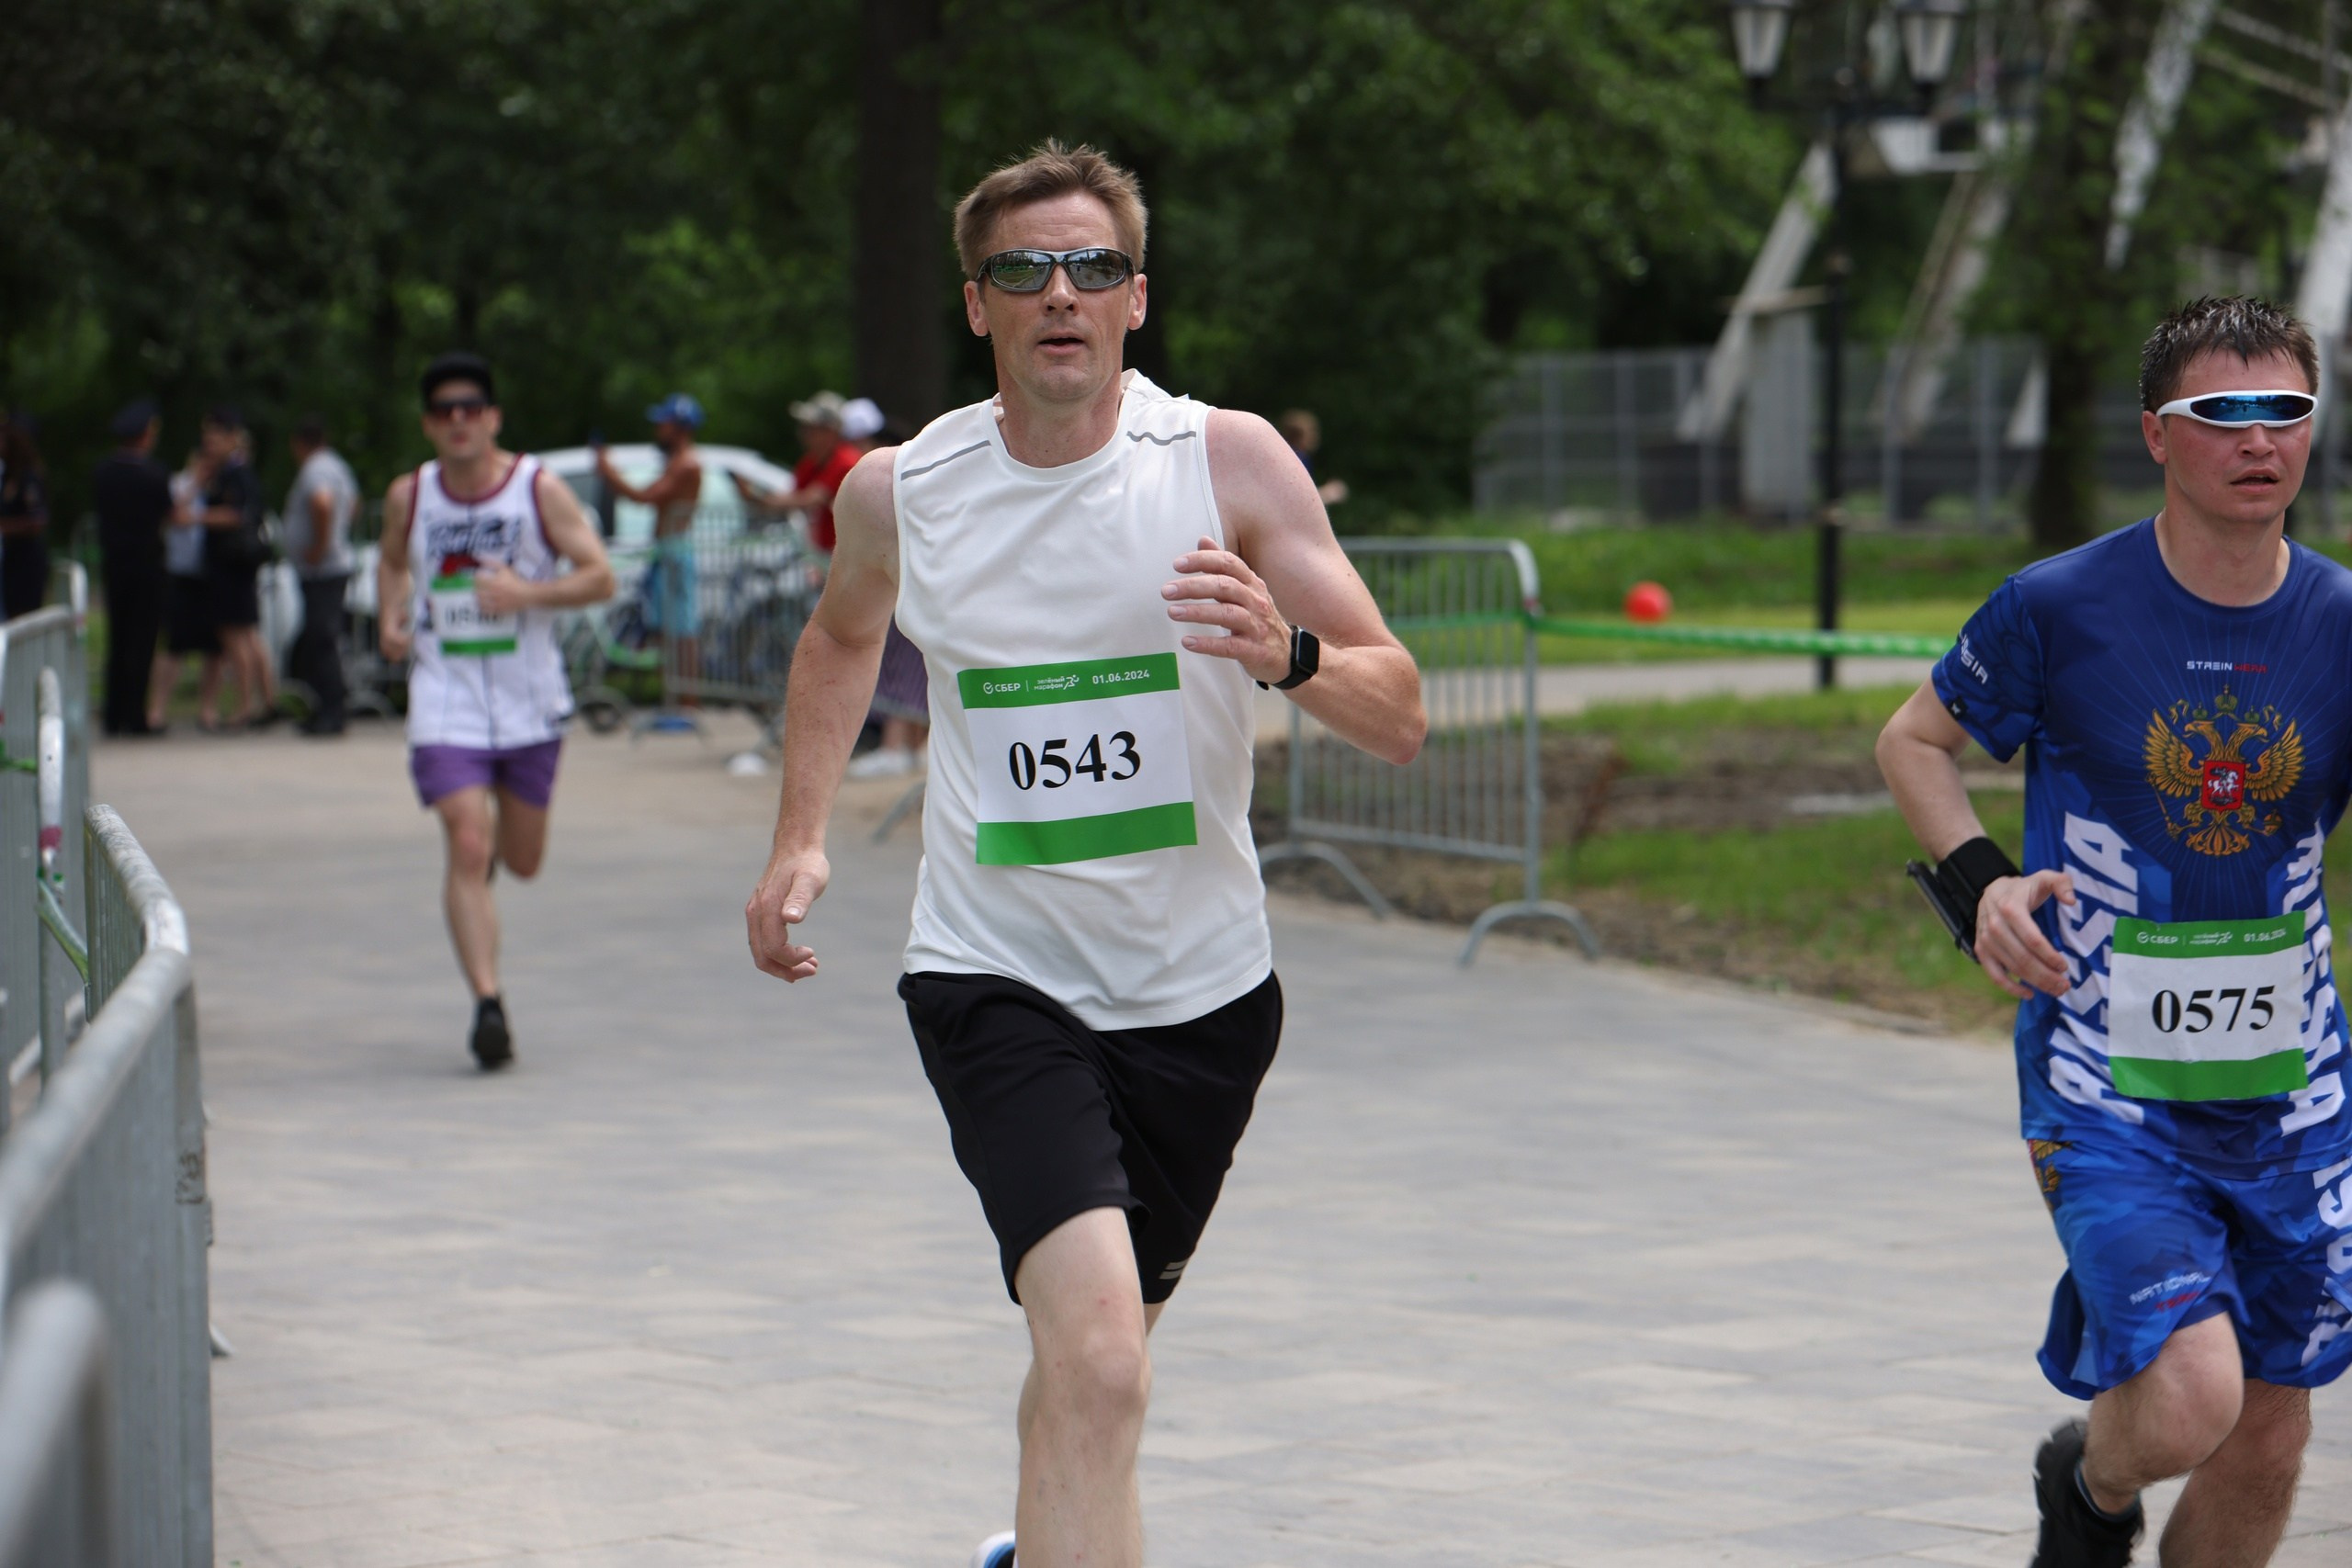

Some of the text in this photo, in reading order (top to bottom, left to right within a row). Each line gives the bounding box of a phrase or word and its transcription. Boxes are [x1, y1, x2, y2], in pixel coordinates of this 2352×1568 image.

[994, 682, 1021, 692] СБЕР
[1091, 669, 1150, 684] 01.06.2024
[1009, 730, 1141, 790] 0543
[2152, 985, 2275, 1032] 0575
